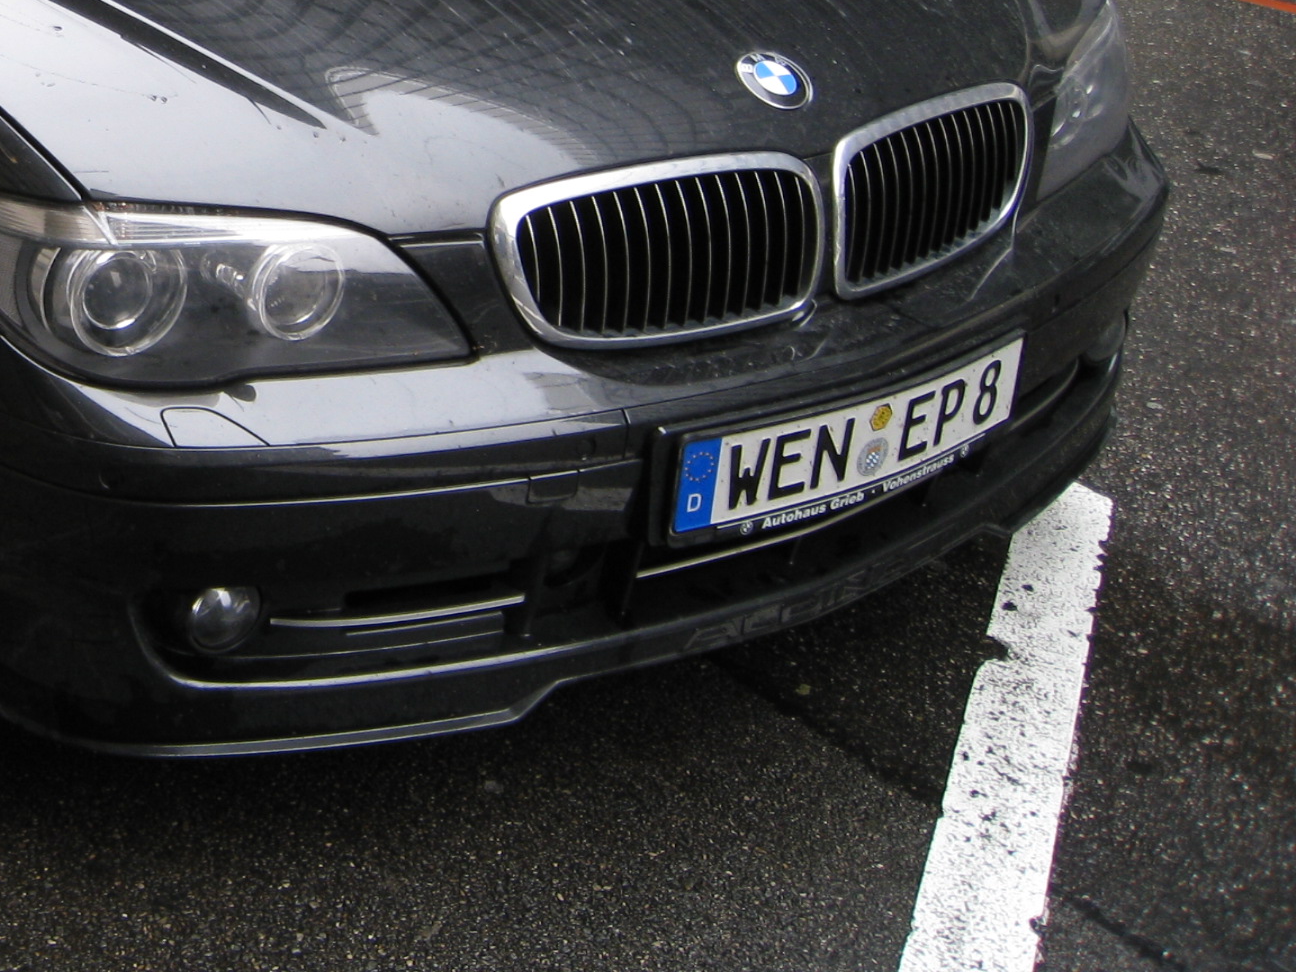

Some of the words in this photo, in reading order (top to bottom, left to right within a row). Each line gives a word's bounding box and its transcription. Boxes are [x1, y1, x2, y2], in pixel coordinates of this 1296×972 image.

[728, 417, 856, 511] WEN
[897, 379, 966, 462] EP
[972, 359, 1002, 426] 8
[686, 494, 702, 513] D
[761, 503, 827, 530] Autohaus
[829, 490, 865, 511] Grieb
[881, 454, 955, 493] Vohenstrauss
